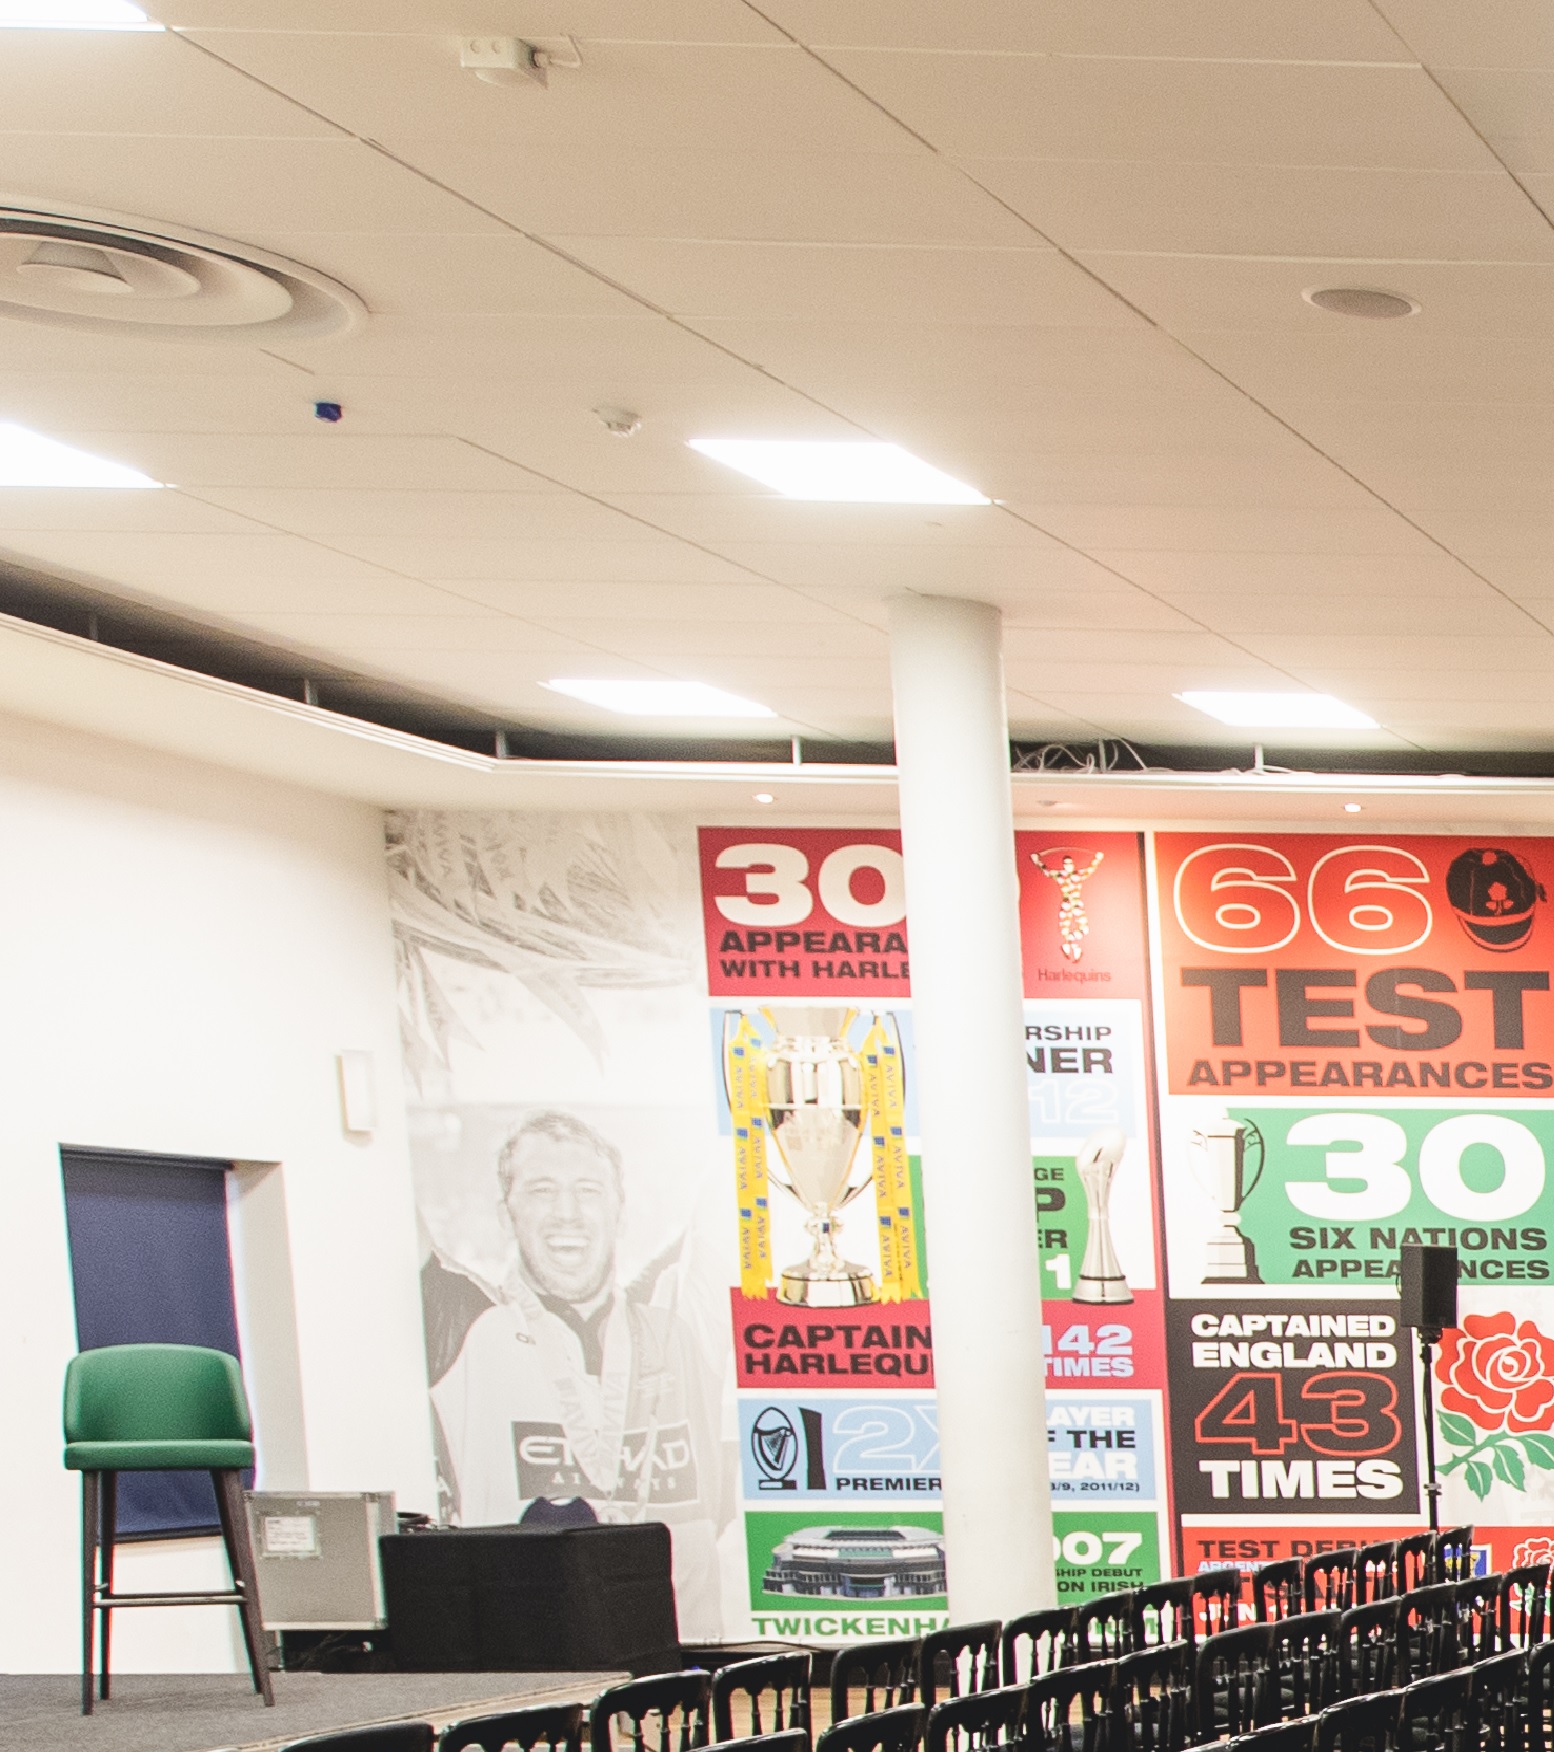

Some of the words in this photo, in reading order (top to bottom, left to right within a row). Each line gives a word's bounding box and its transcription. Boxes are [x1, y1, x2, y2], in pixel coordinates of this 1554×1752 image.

[1173, 843, 1434, 955] 66
[719, 958, 800, 979] WITH
[1038, 968, 1112, 984] Harlequins
[1180, 966, 1551, 1051] TEST
[1186, 1060, 1554, 1090] APPEARANCES
[1284, 1112, 1546, 1223] 30
[1289, 1226, 1357, 1251] SIX
[1370, 1226, 1548, 1252] NATIONS
[1291, 1258, 1551, 1280] APPEANCES
[1190, 1313, 1397, 1339] CAPTAINED
[1043, 1356, 1135, 1378] TIMES
[1191, 1342, 1397, 1368] ENGLAND
[1194, 1372, 1401, 1457] 43
[1066, 1430, 1136, 1448] THE
[1199, 1459, 1404, 1499] TIMES
[1197, 1540, 1280, 1559] TEST
[1091, 1568, 1143, 1578] DEBUT
